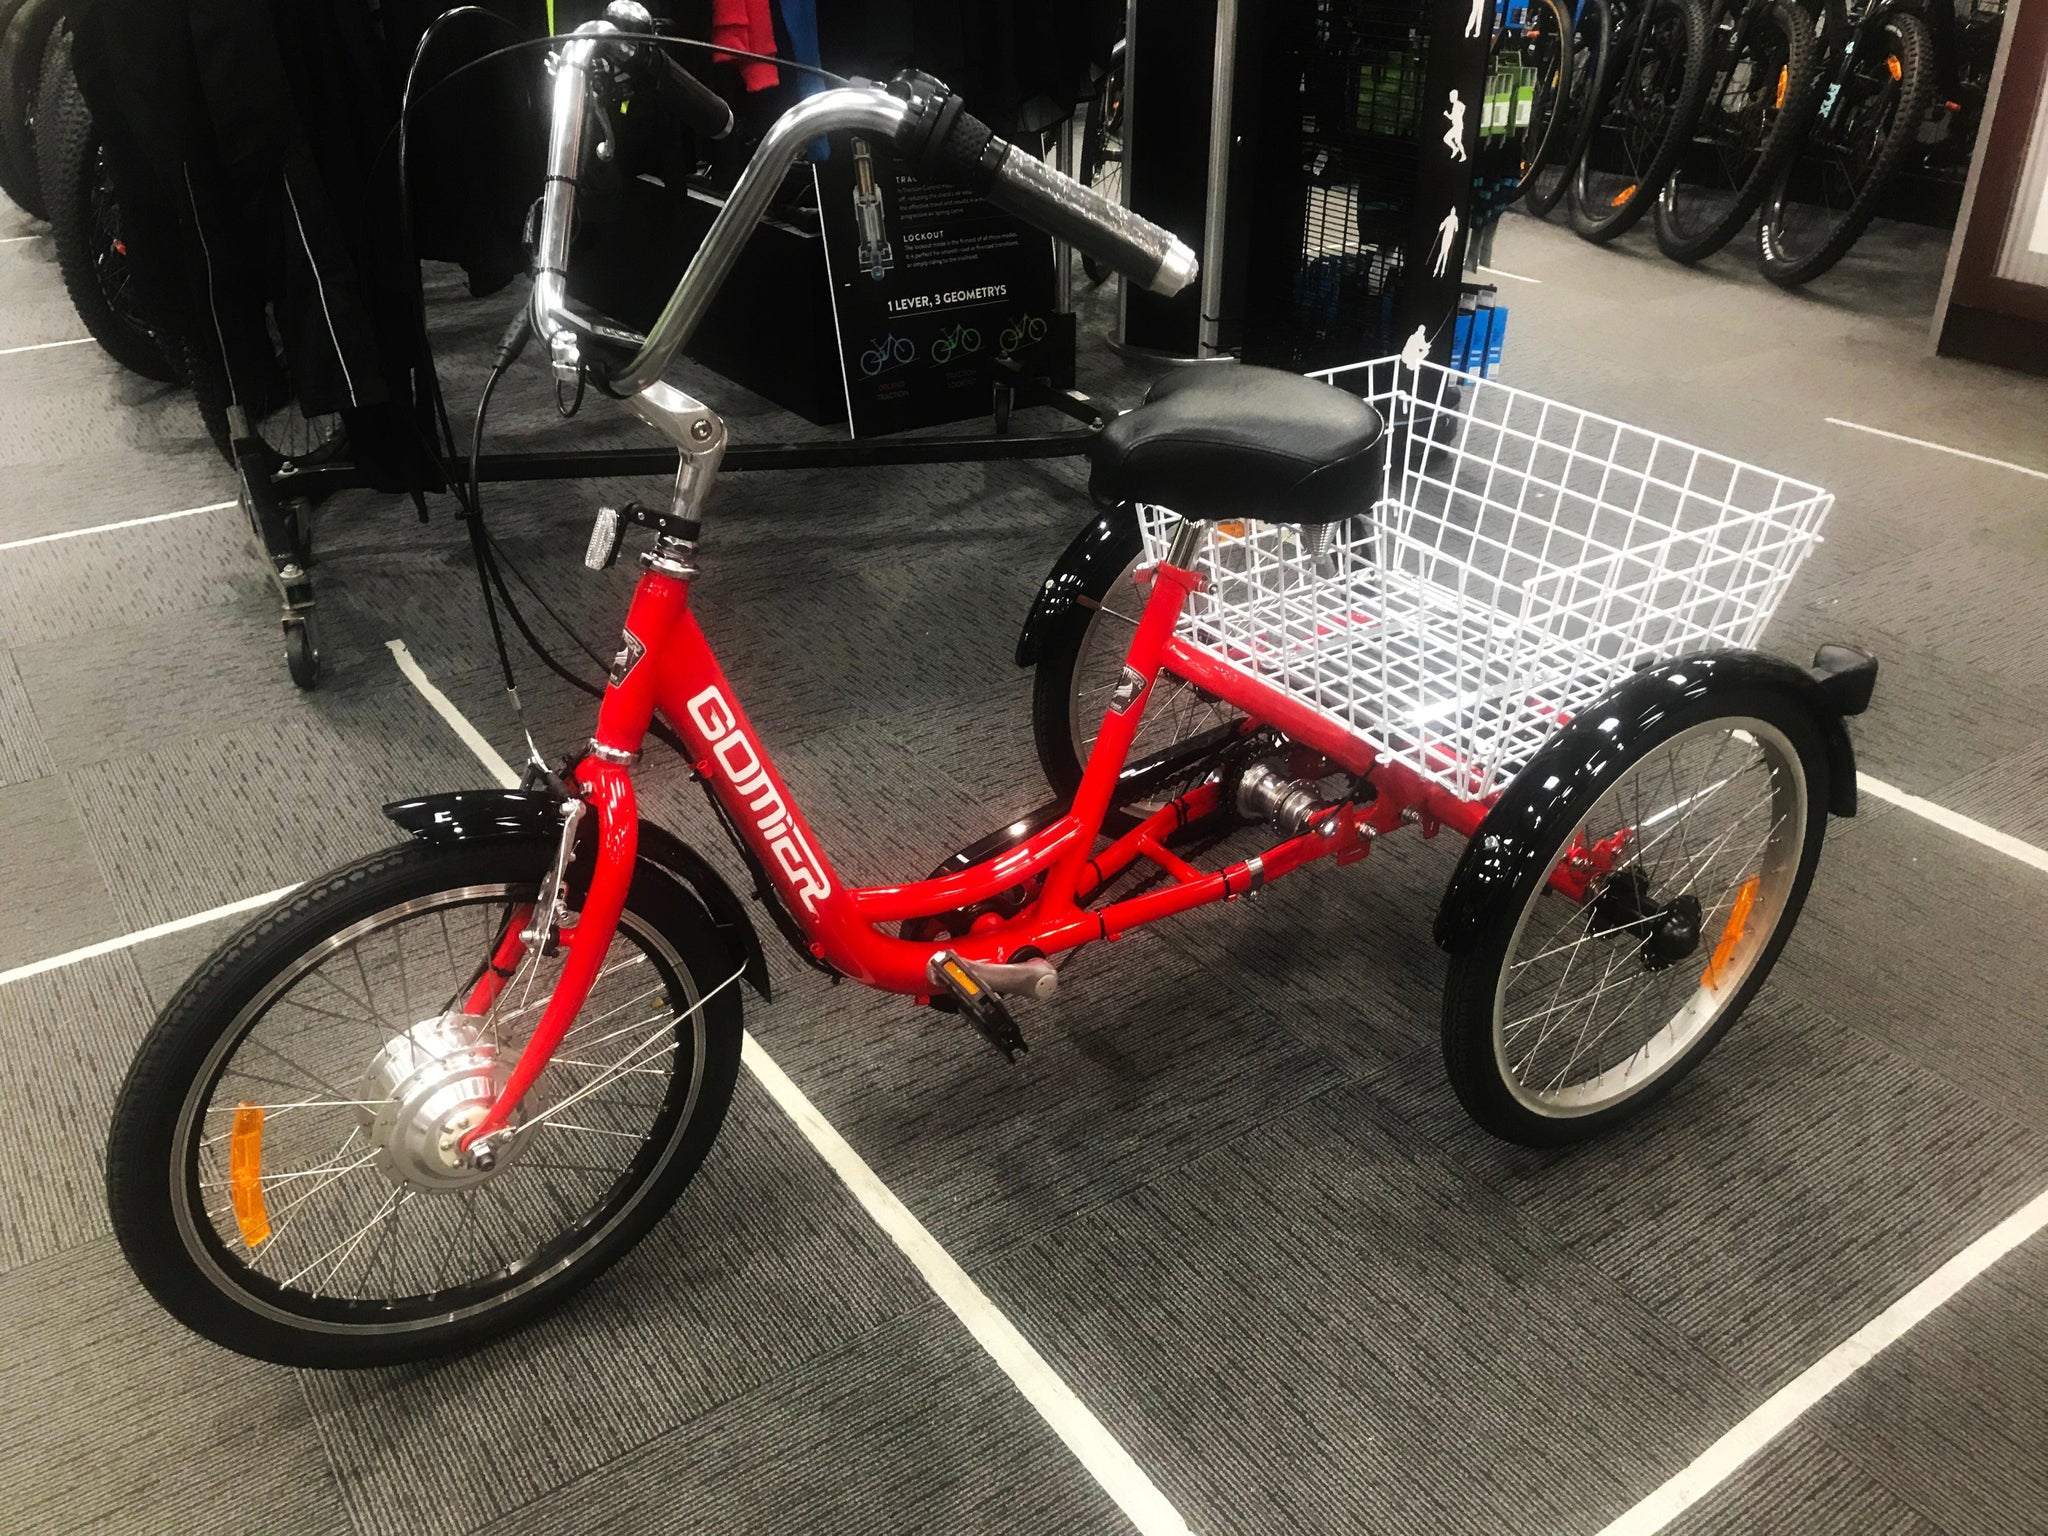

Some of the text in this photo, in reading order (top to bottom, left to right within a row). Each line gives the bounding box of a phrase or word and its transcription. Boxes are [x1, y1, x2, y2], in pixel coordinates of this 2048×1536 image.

[903, 230, 944, 243] LOCKOUT
[887, 284, 1007, 311] 1 LEVER, 3 GEOMETRYS
[686, 684, 832, 913] GOMIER
